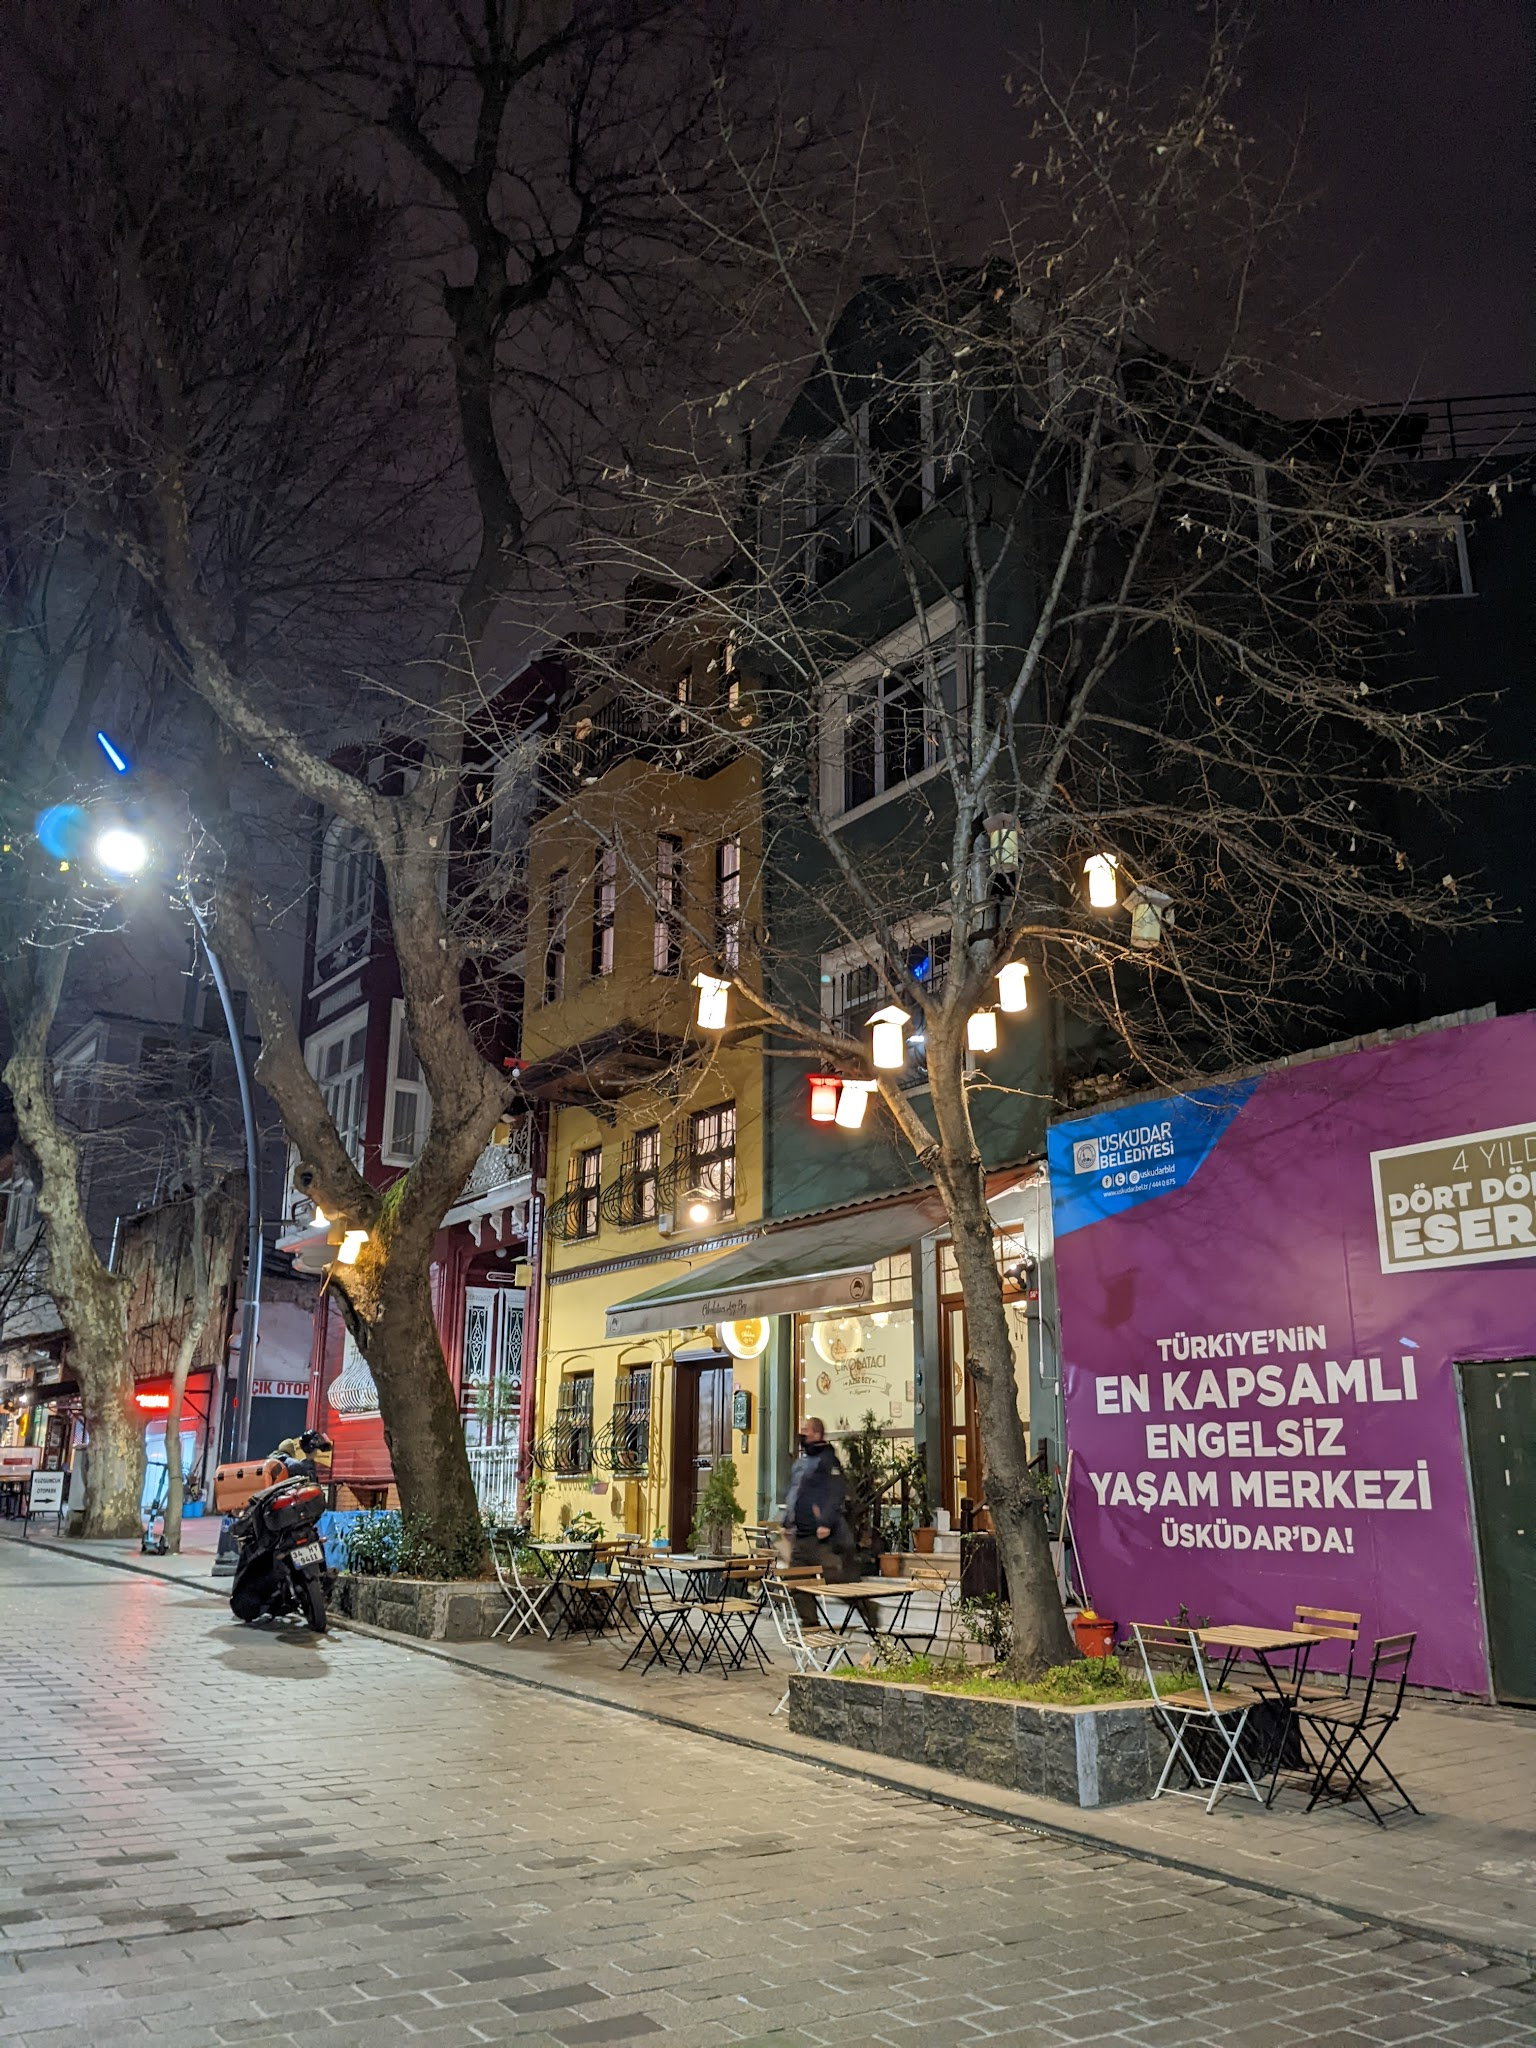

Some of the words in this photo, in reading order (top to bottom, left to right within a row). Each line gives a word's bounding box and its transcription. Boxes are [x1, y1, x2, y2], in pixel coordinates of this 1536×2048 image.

[1099, 1122, 1172, 1153] ÜSKÜDAR
[1100, 1140, 1175, 1169] BELEDİYESİ
[1140, 1164, 1176, 1179] uskudarbld
[1452, 1149, 1469, 1172] 4
[1388, 1182, 1473, 1217] DÖRT
[1480, 1166, 1536, 1204] DÖ
[1391, 1203, 1536, 1259] ESER
[1156, 1325, 1327, 1362] TÜRKİYE'NİN
[252, 1381, 272, 1395] ÇIK
[276, 1382, 309, 1396] OTOP
[1096, 1374, 1150, 1414] EN
[1162, 1356, 1418, 1412] KAPSAMLI
[1145, 1417, 1346, 1459] ENGELSİZ
[1088, 1471, 1219, 1514] YAŞAM
[1230, 1460, 1432, 1510] MERKEZİ
[1161, 1517, 1354, 1553] ÜSKÜDAR'DA!
[292, 1550, 303, 1559] 34
